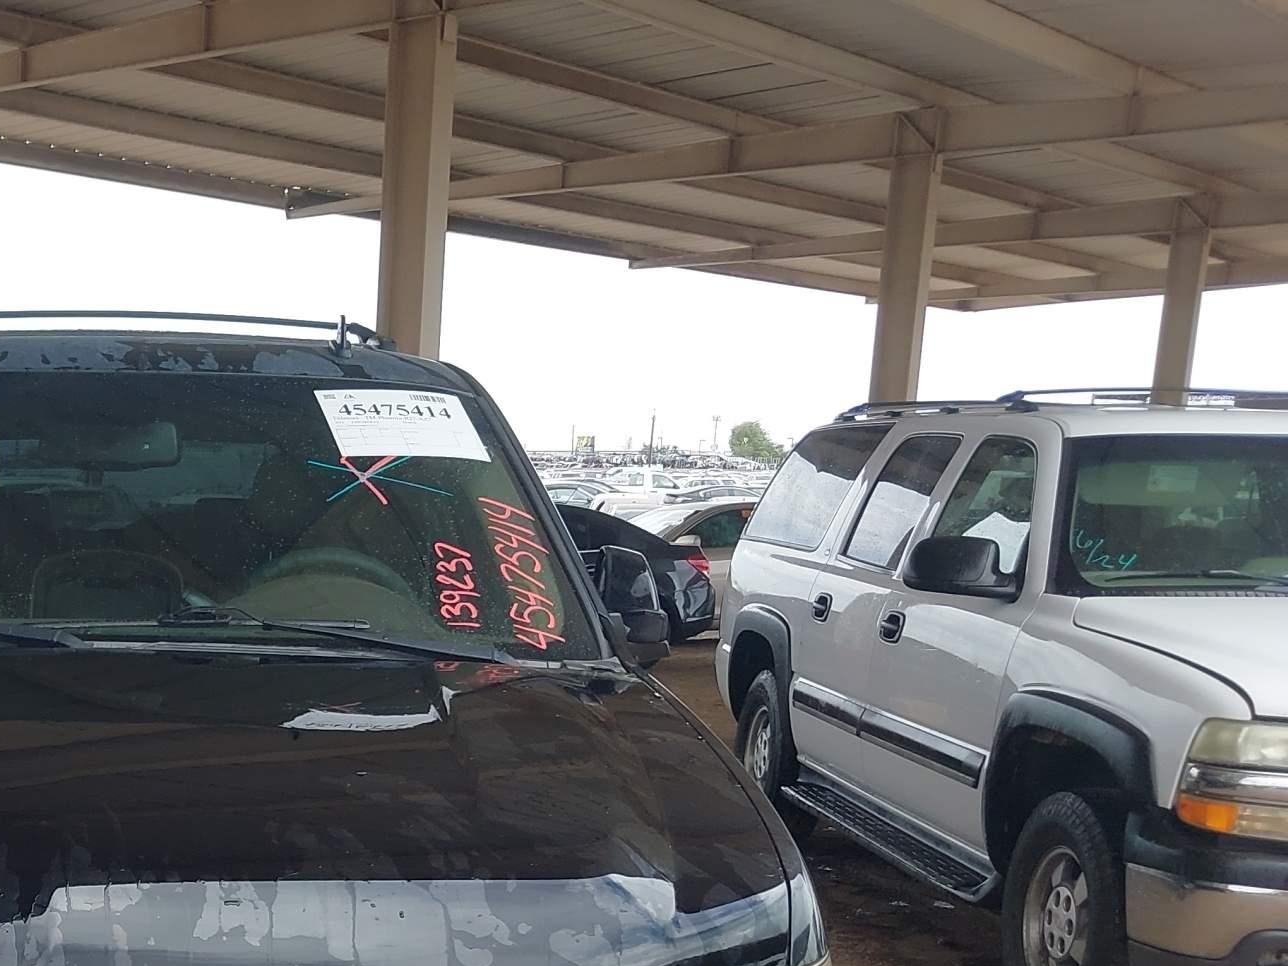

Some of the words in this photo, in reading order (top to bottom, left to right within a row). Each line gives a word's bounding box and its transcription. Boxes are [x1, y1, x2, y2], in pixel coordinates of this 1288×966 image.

[338, 403, 452, 419] 45475414
[1075, 529, 1137, 570] 6/24
[478, 497, 566, 650] 45475414
